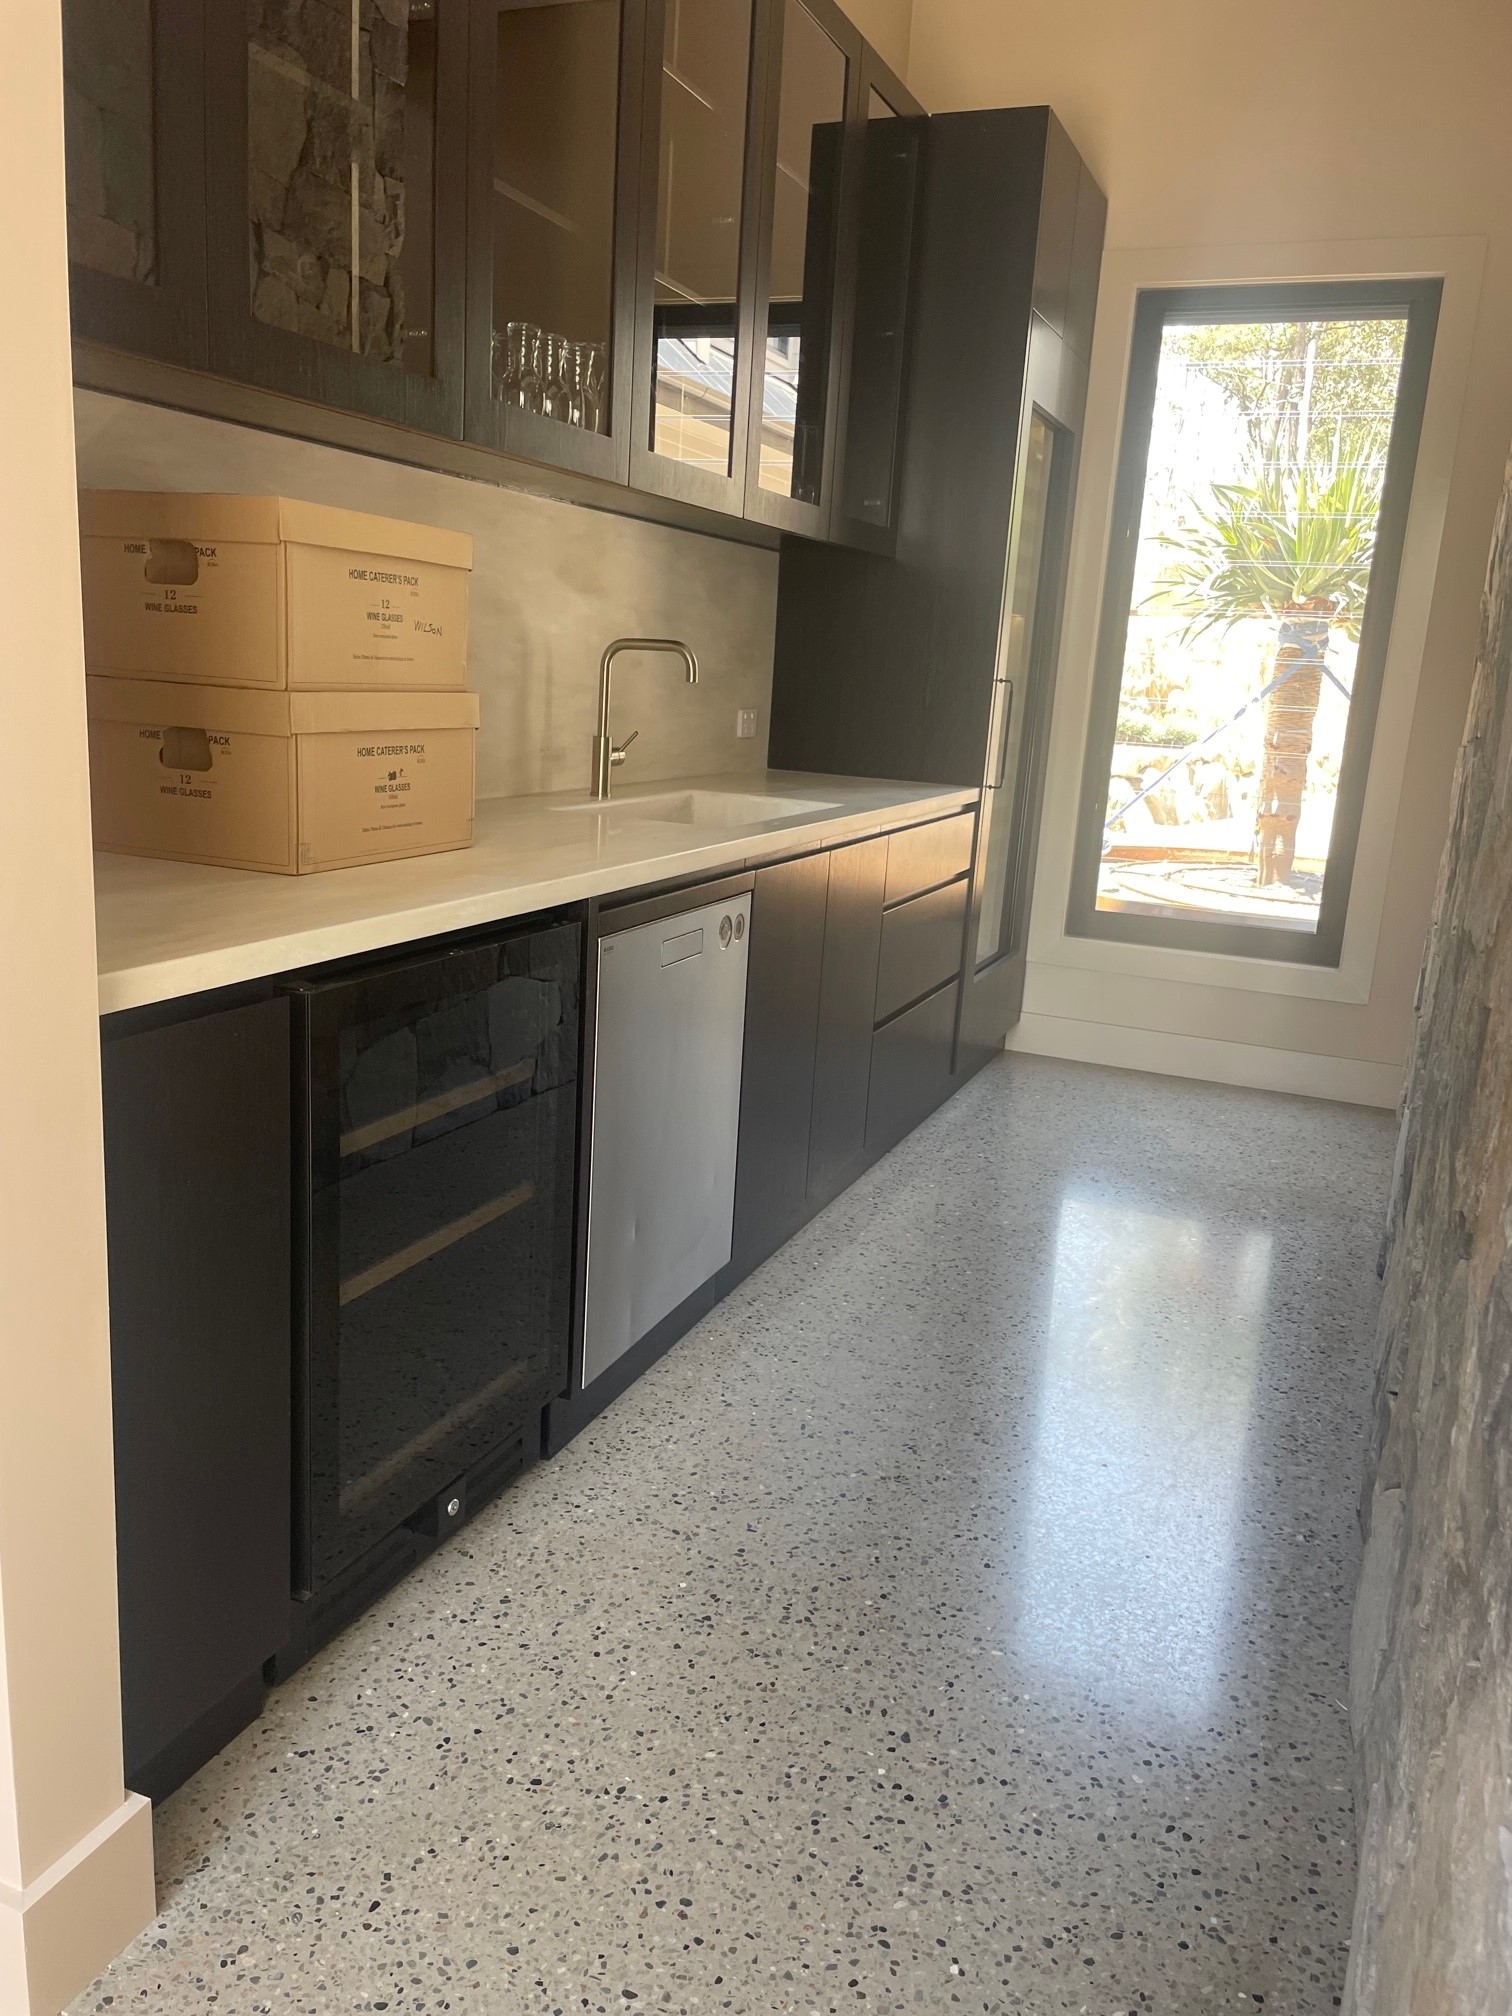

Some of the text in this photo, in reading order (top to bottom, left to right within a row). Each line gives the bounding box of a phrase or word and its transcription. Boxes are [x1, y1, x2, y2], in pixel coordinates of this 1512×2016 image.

[124, 543, 217, 558] HOME PACK
[348, 569, 419, 587] HOME CATERER'S PACK
[164, 589, 177, 600] 12
[144, 601, 198, 614] WINE GLASSES
[381, 599, 390, 609] 12
[366, 611, 403, 623] WINE GLASSES
[139, 729, 231, 746] HOME PACK
[357, 744, 425, 757] HOME CATERER'S PACK
[180, 774, 192, 785] 12
[160, 785, 212, 799] WINE GLASSES
[374, 782, 411, 793] WINE GLASSES
